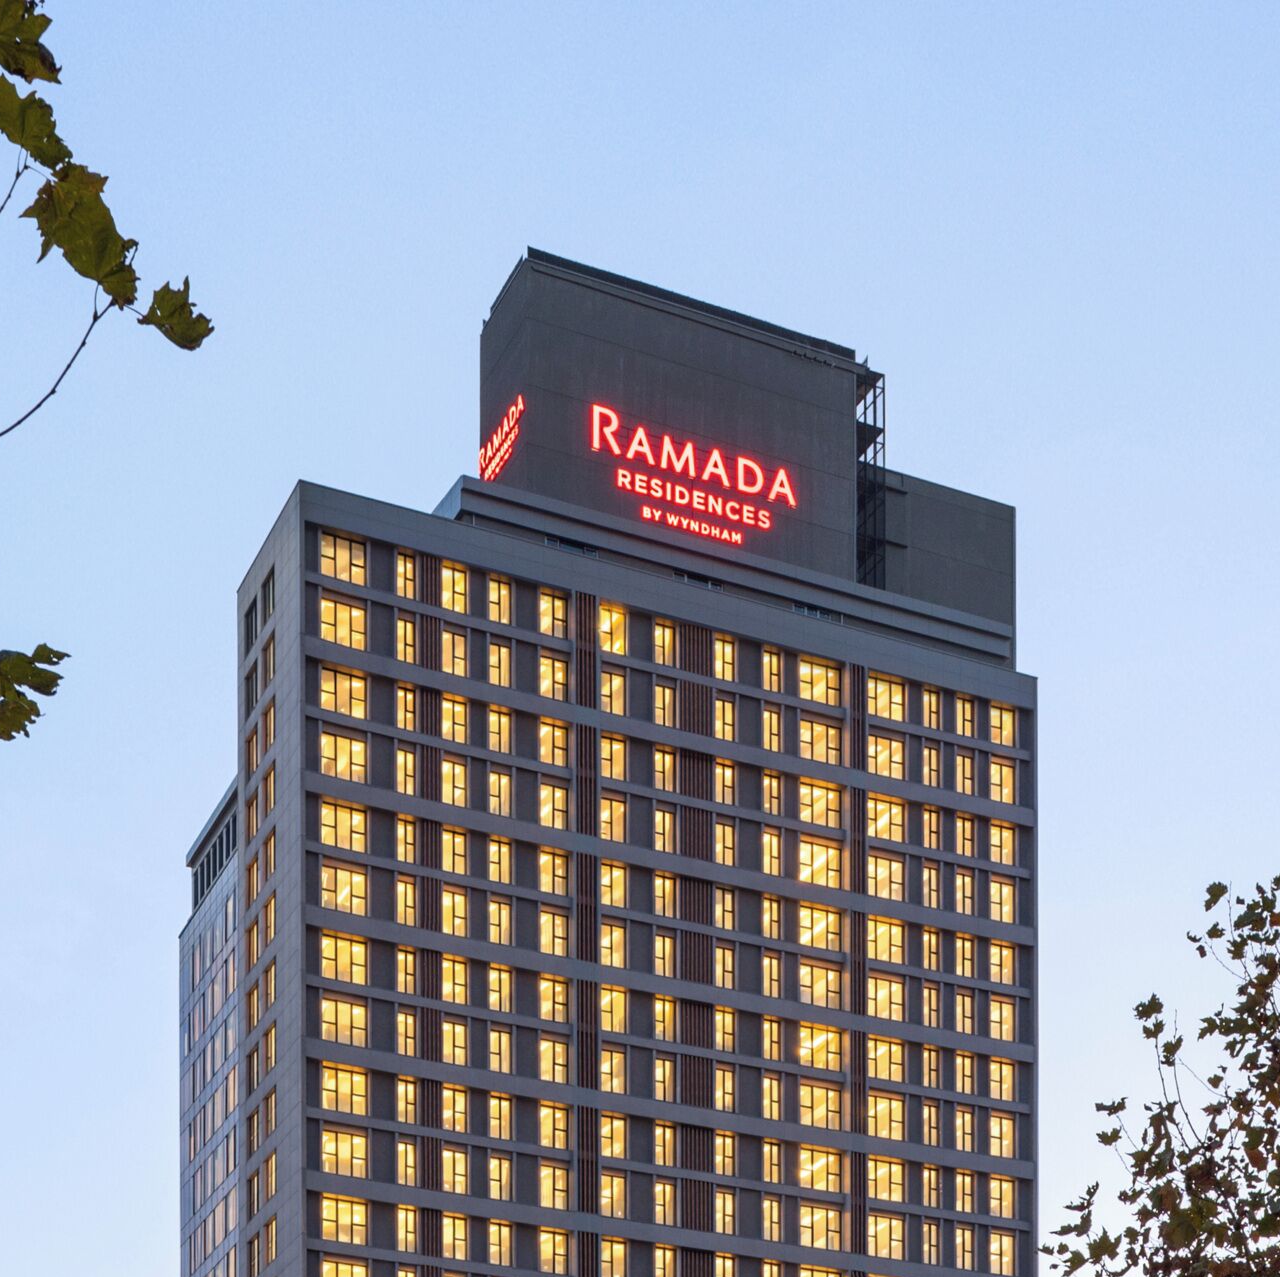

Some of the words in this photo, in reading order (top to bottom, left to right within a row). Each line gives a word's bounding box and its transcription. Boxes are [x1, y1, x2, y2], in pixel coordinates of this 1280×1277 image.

[477, 393, 524, 477] RAMADA
[590, 403, 797, 508] RAMADA
[617, 468, 771, 529] RESIDENCES
[642, 505, 662, 522] BY
[666, 512, 742, 545] WYNDHAM
